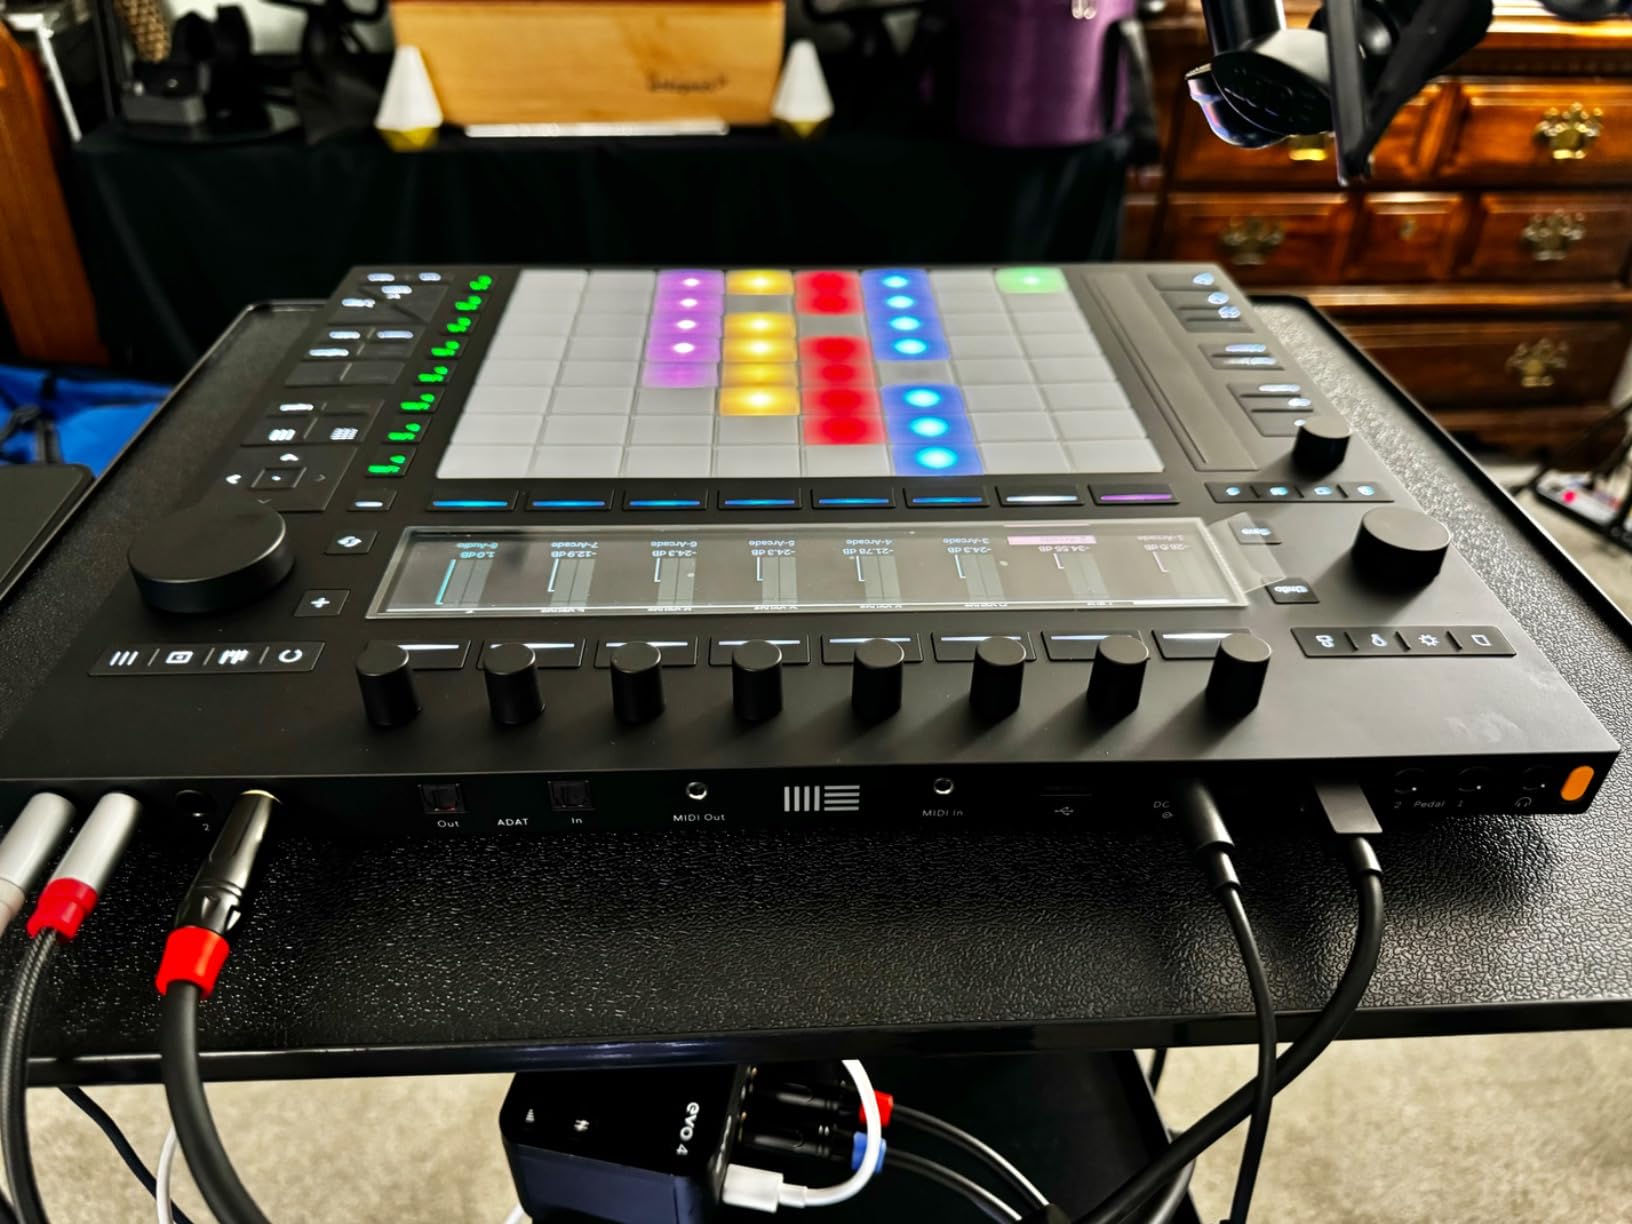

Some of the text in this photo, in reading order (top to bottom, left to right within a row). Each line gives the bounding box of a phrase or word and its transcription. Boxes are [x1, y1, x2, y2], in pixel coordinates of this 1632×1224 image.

[551, 541, 599, 549] 7-Arcade
[551, 550, 567, 558] dB
[652, 549, 697, 557] -24.3 dB
[751, 548, 796, 556] -24.3 dB
[842, 547, 857, 555] dB
[1413, 800, 1446, 808] Pedal
[922, 809, 964, 817] MIDI In
[571, 816, 583, 824] In
[673, 813, 726, 822] MIDI Out
[437, 820, 460, 828] Out
[497, 818, 529, 826] ADAT
[676, 1101, 700, 1156] evo 4
